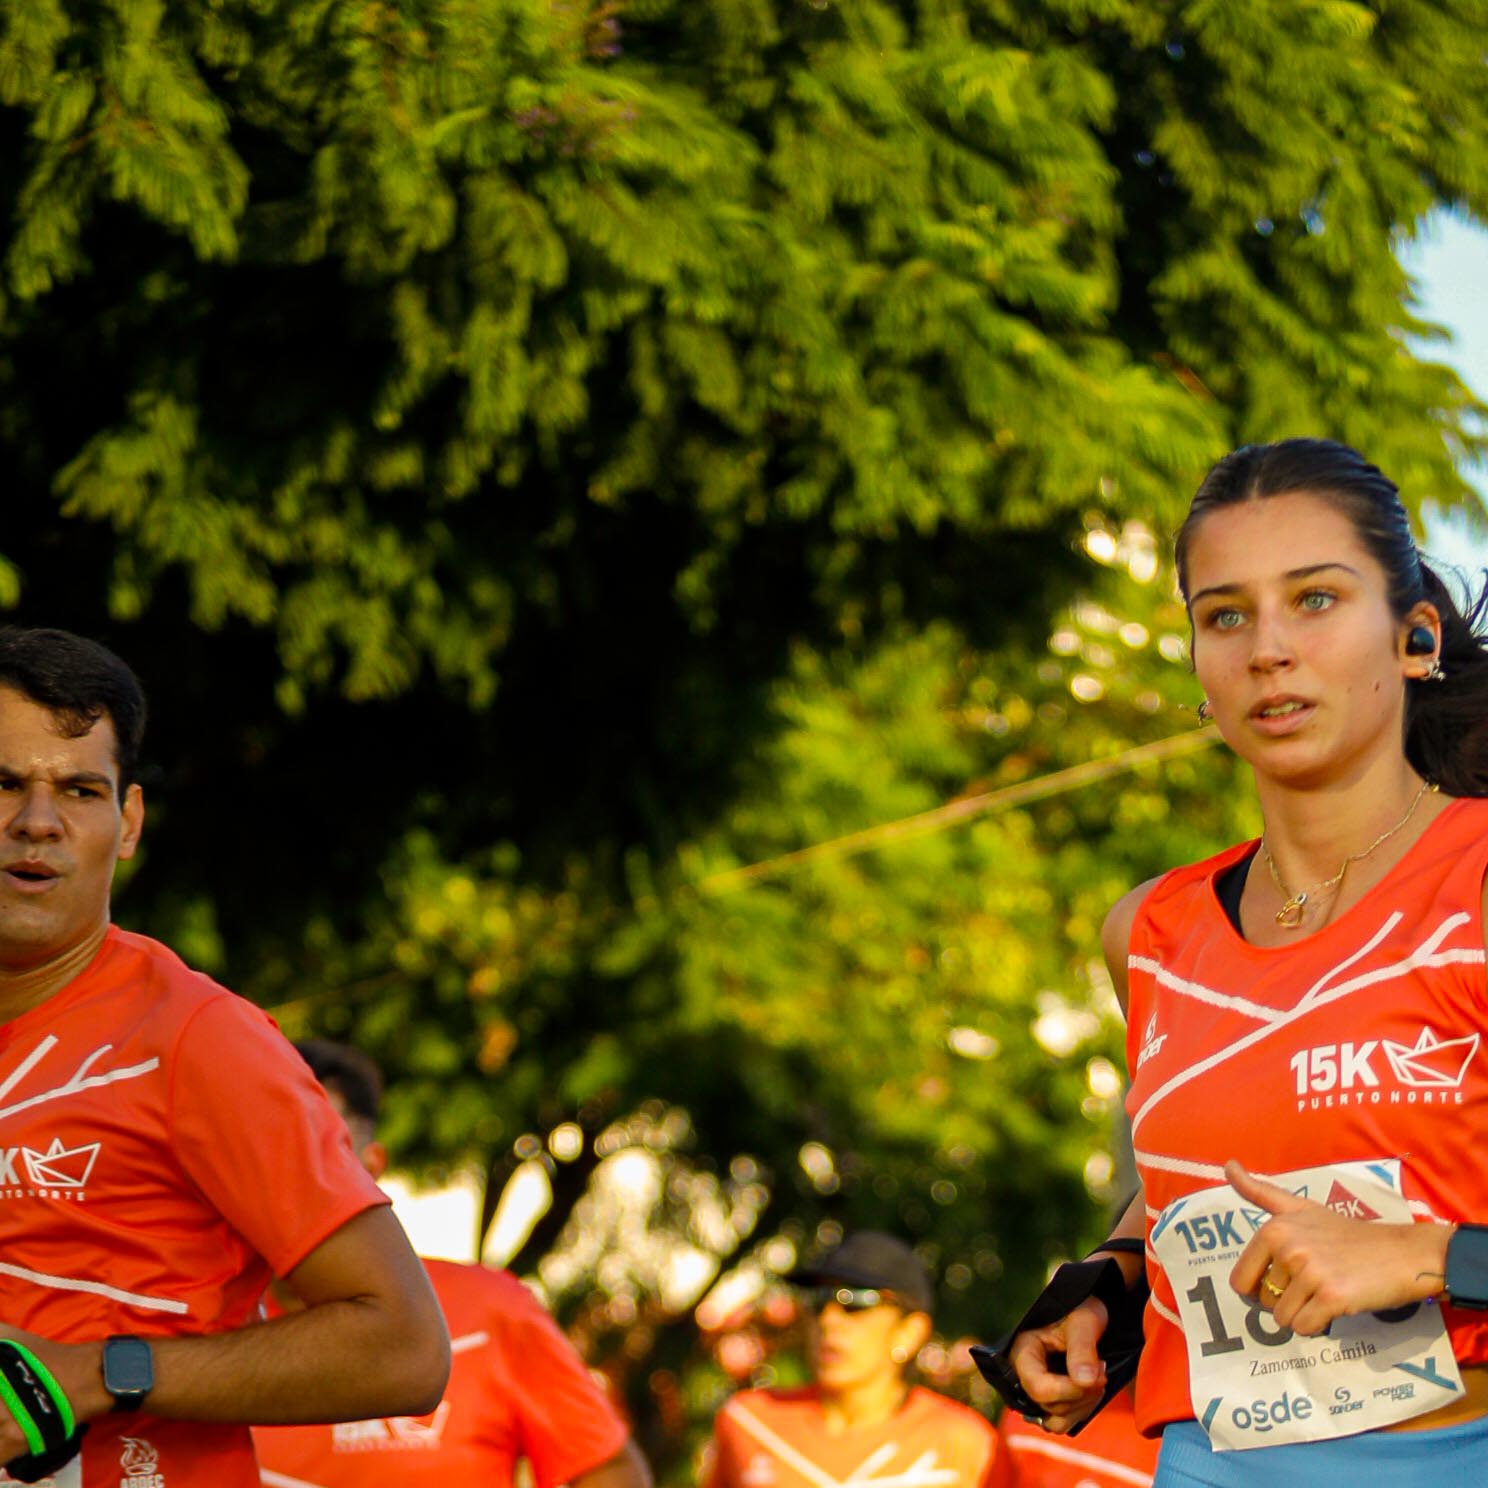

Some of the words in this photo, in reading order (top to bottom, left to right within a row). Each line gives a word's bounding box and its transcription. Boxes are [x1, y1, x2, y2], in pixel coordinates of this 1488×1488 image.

[1289, 1040, 1380, 1095] 15K
[1297, 1091, 1380, 1113] PUERTO
[1390, 1090, 1464, 1105] NORTE
[1174, 1207, 1246, 1253] 15K
[1186, 1275, 1418, 1357] 18
[1250, 1355, 1317, 1377] Zamorano
[1320, 1341, 1377, 1365] Camila
[1231, 1390, 1313, 1432] osde
